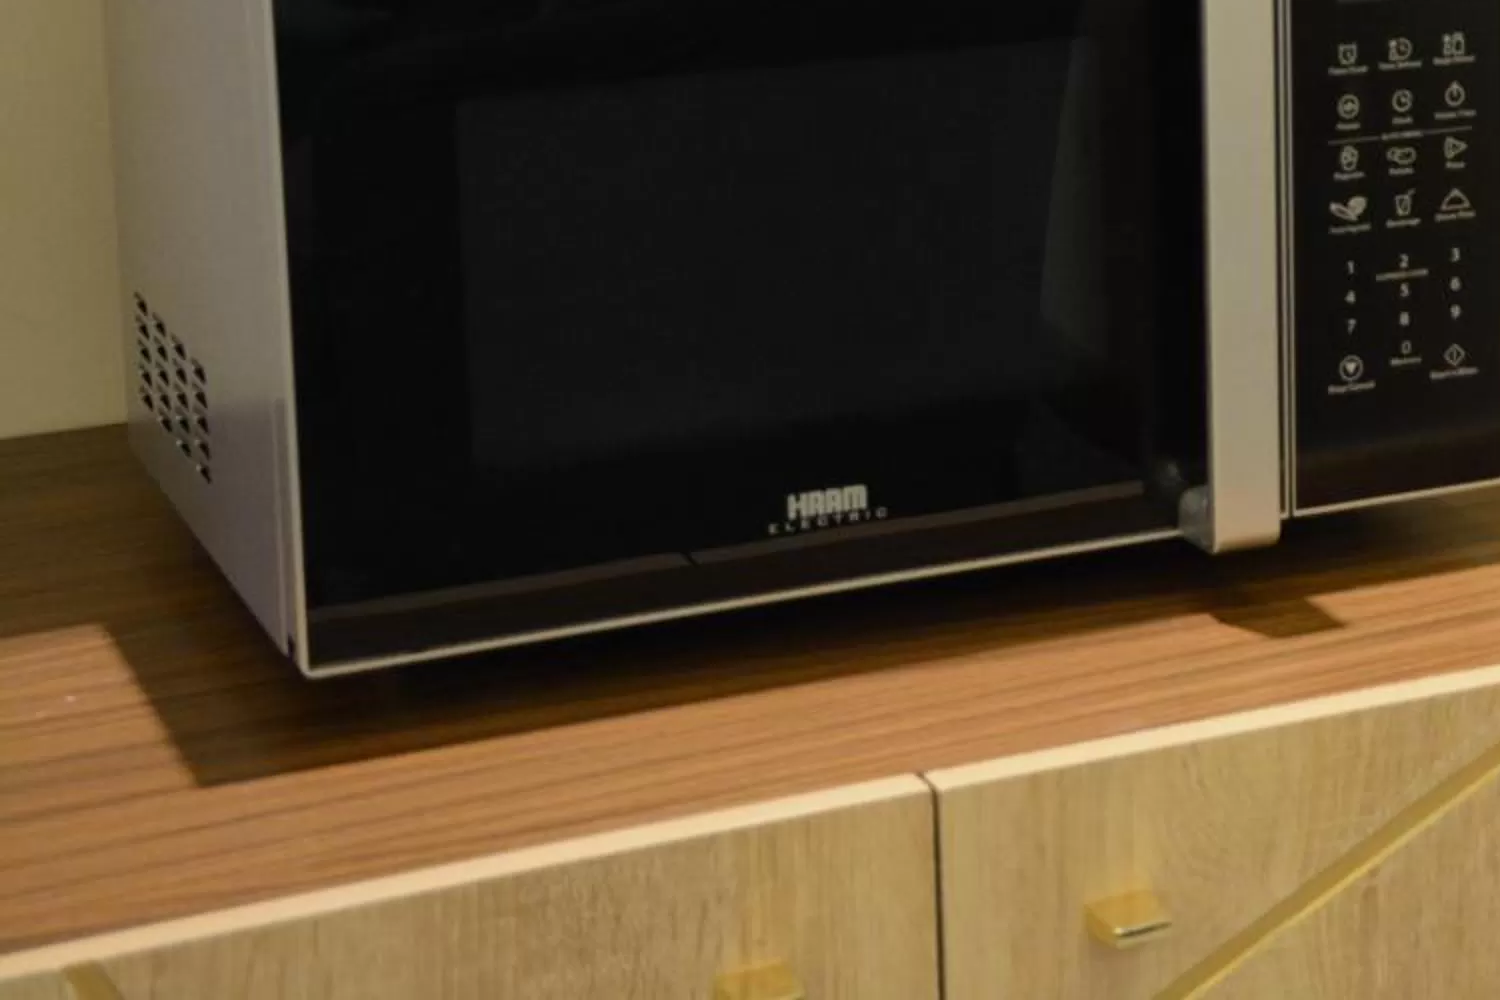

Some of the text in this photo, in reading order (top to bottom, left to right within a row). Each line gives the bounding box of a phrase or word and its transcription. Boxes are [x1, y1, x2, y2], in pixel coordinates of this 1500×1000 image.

[1347, 260, 1354, 275] 1
[1400, 253, 1409, 268] 2
[1345, 290, 1356, 304] 4
[1347, 318, 1356, 334] 7
[1401, 340, 1412, 354] 0
